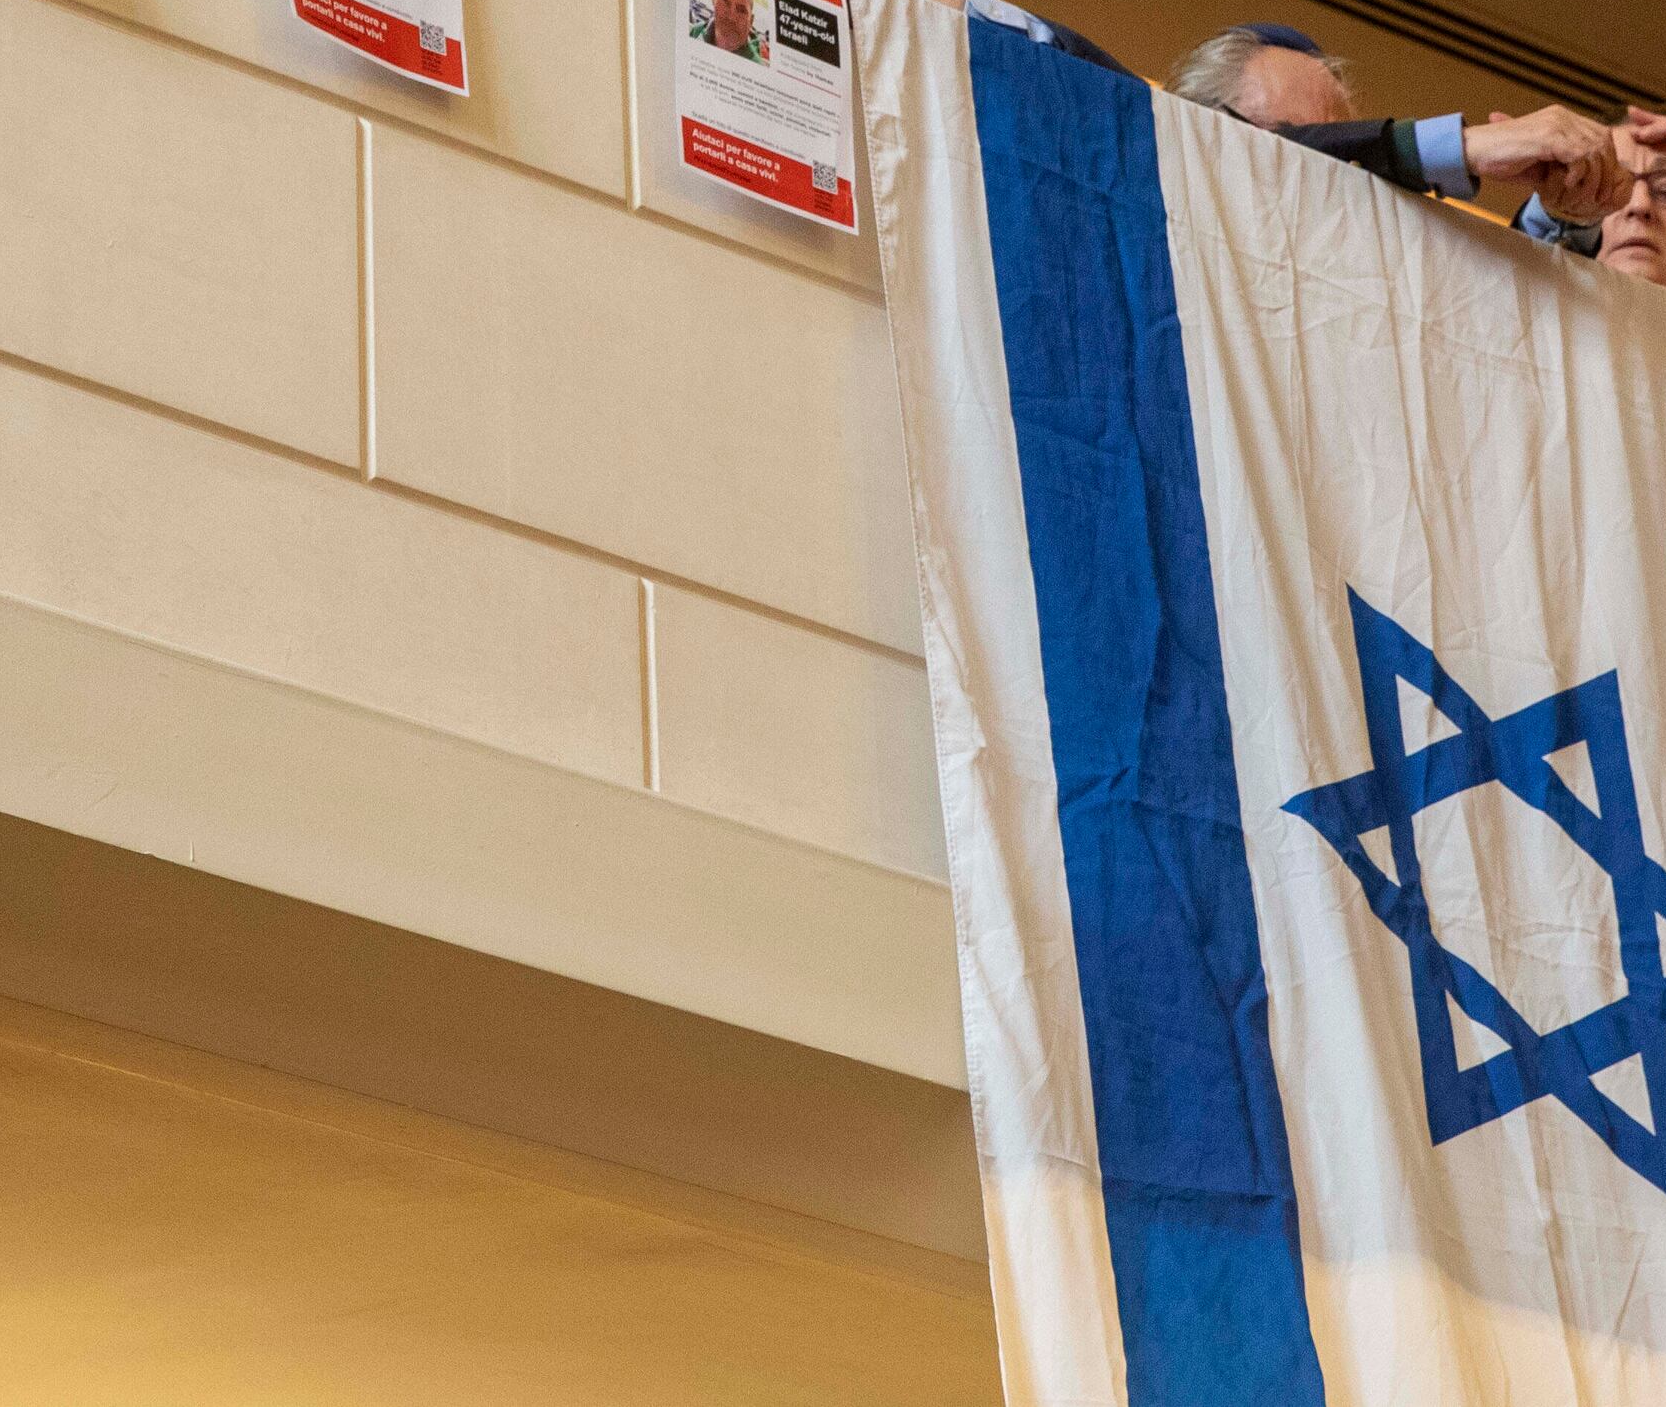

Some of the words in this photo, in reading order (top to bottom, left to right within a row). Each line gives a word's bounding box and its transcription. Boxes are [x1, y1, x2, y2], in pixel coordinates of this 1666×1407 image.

[334, 12, 341, 23] a
[342, 15, 364, 34] casa
[365, 25, 385, 43] vivi.
[349, 5, 379, 28] favore
[380, 20, 387, 31] a
[778, 0, 799, 17] Elad
[800, 9, 827, 29] Katzir
[779, 12, 835, 46] 47-years-old
[779, 24, 807, 45] Israeli
[691, 126, 723, 149] Aiutaci
[725, 141, 741, 158] per
[742, 148, 772, 168] favore
[773, 161, 780, 172] a
[692, 140, 726, 163] portarli
[727, 155, 733, 165] a
[735, 158, 757, 175] casa
[758, 166, 778, 183] vivi.
